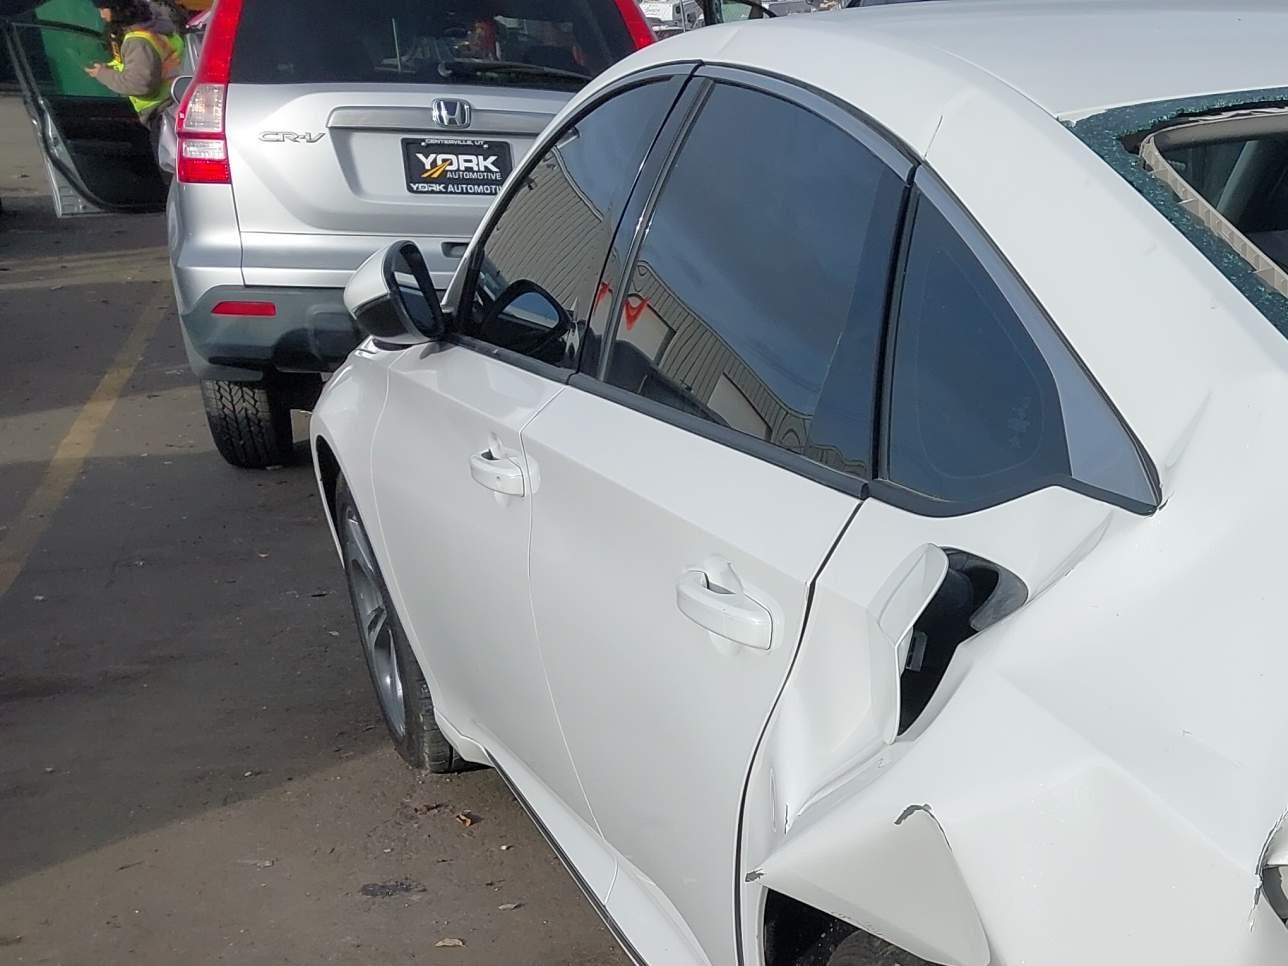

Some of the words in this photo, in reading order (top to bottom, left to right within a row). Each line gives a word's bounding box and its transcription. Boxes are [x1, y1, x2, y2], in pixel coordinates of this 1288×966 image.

[415, 153, 500, 172] YORK
[446, 171, 503, 180] AUTOMOTIVE
[409, 183, 446, 192] YORK
